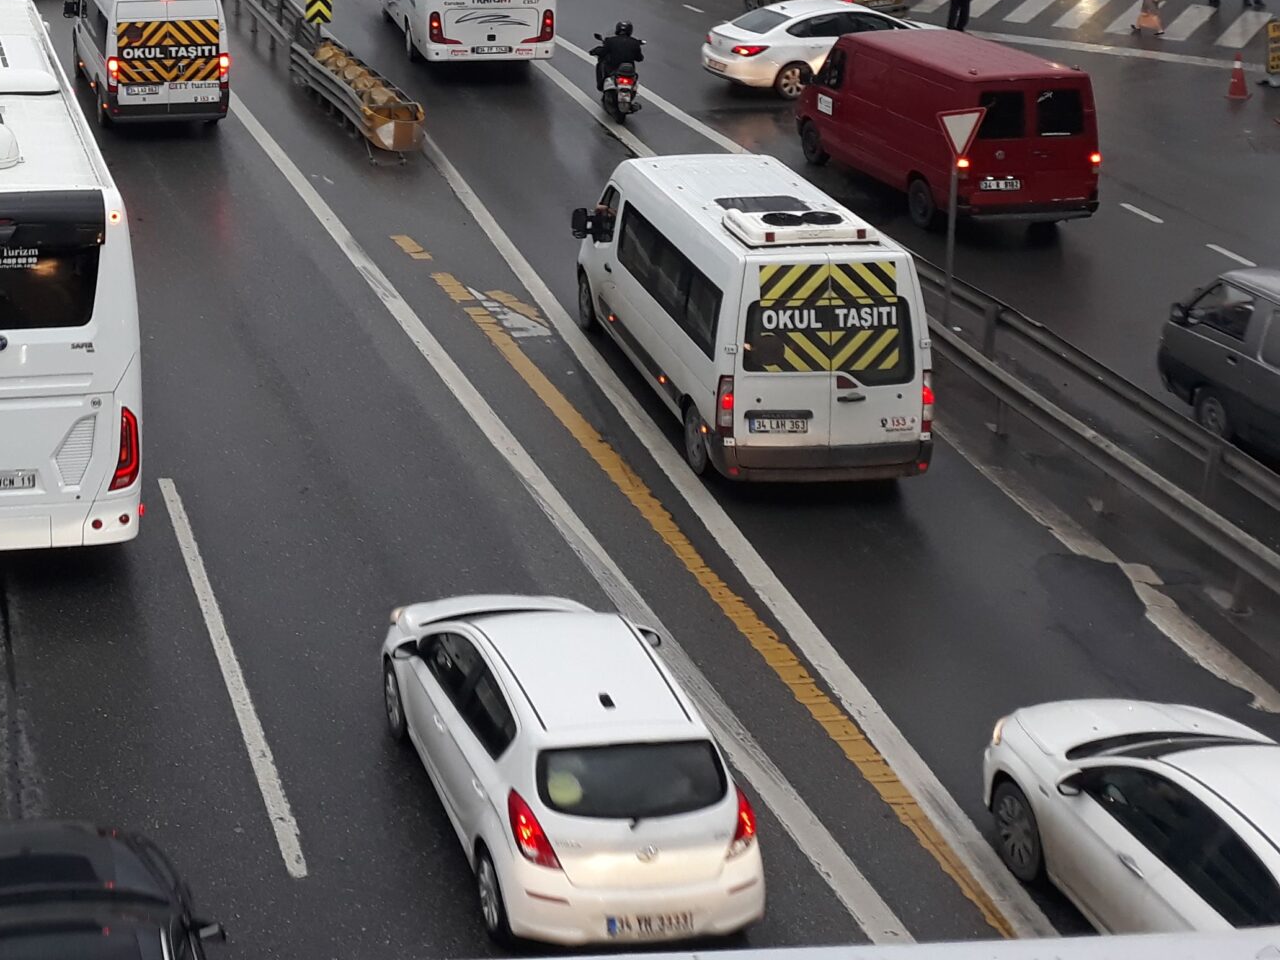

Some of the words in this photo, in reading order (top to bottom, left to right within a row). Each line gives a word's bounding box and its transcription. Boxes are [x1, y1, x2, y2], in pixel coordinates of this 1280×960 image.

[122, 47, 165, 59] OKUL
[169, 45, 217, 59] TAŞITI
[3, 246, 39, 257] Turizm
[761, 309, 823, 330] OKUL
[834, 305, 897, 330] TAŞITI
[756, 419, 766, 430] 34
[770, 419, 786, 430] LAH
